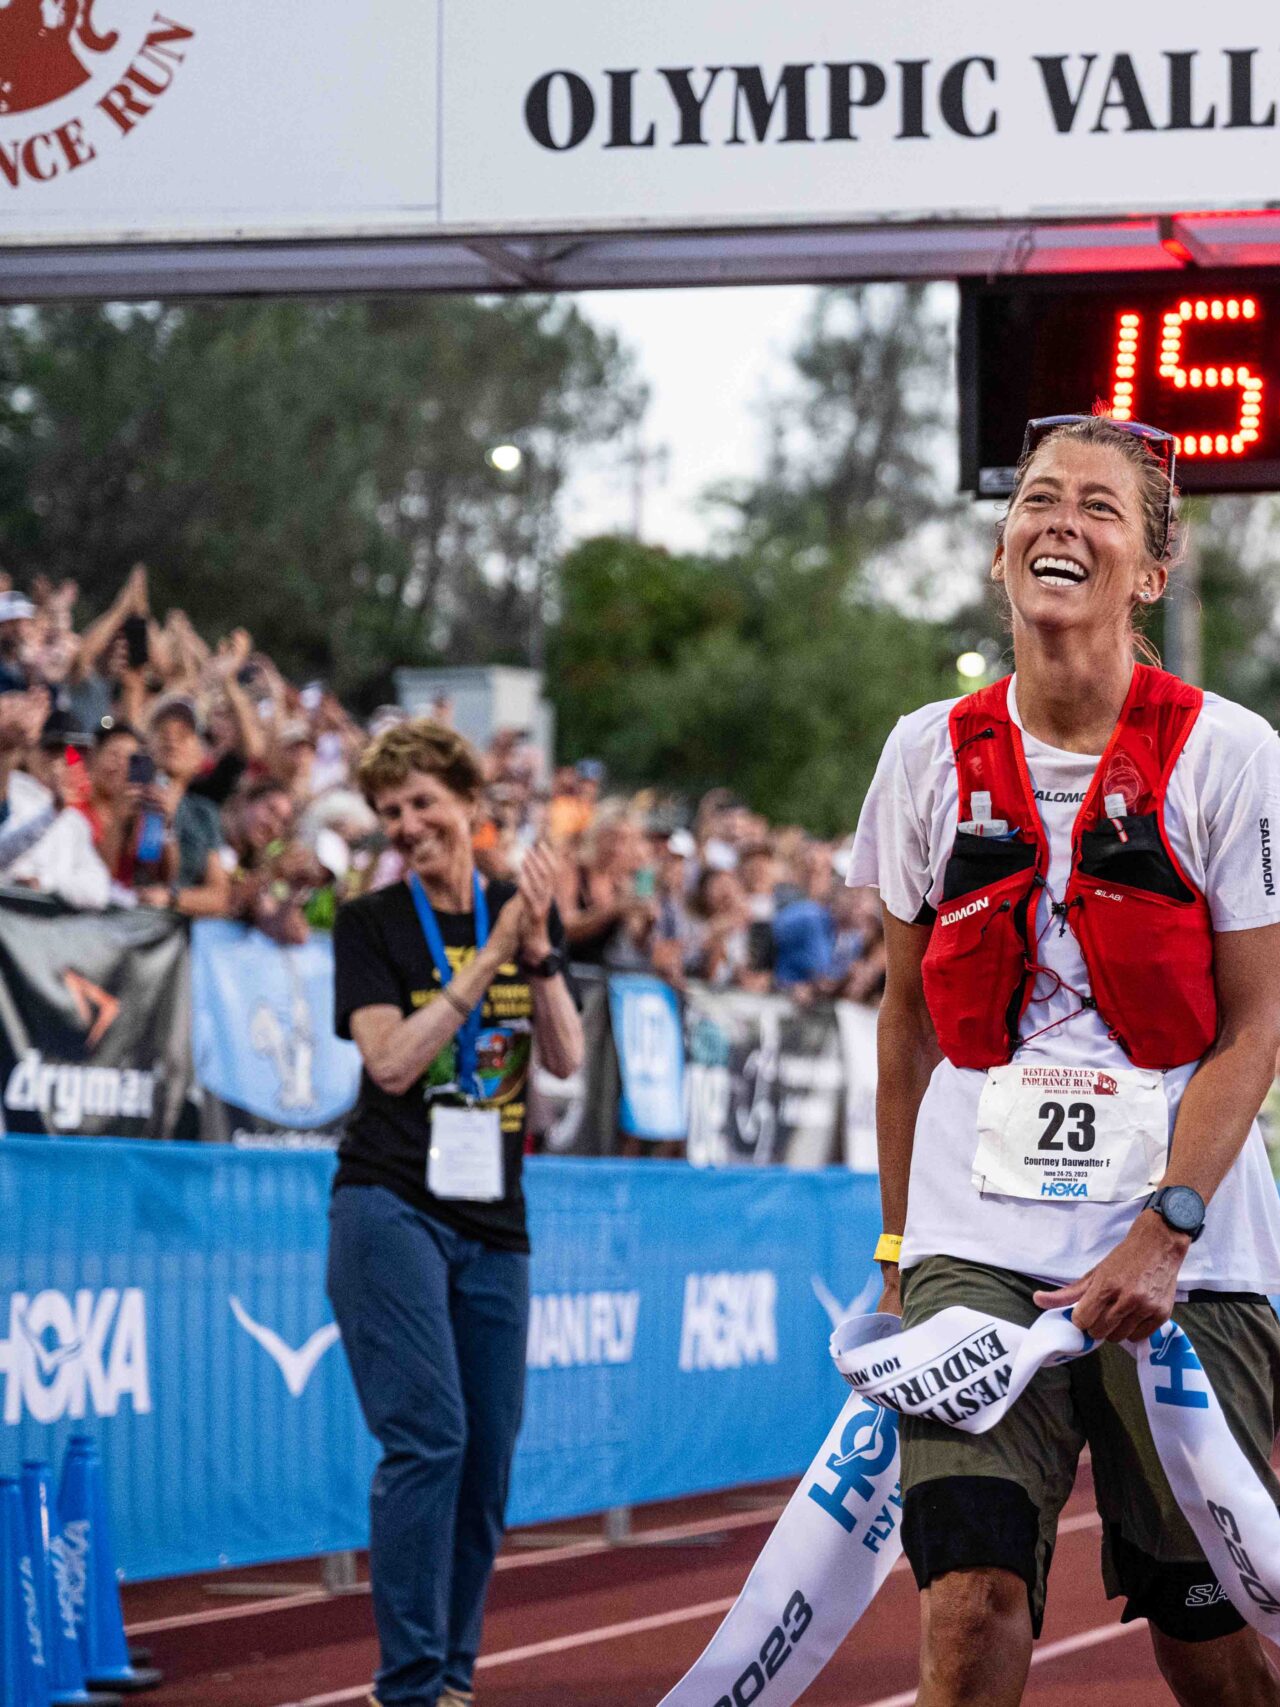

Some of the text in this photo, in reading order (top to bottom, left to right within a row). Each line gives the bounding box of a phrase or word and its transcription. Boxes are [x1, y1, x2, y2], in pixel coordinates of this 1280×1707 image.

[95, 12, 195, 138] RUN
[522, 56, 998, 151] OLYMPIC
[1259, 817, 1276, 896] SALOMON
[1021, 1077, 1093, 1087] ENDURANCE RUN
[1022, 1067, 1095, 1078] WESTERN STATES
[1037, 1101, 1096, 1152] 23
[1023, 1156, 1060, 1167] Courtney
[1061, 1157, 1104, 1168] Dauwalter
[1040, 1182, 1089, 1197] HOKA
[872, 1357, 901, 1379] 100
[862, 1504, 896, 1554] FLY
